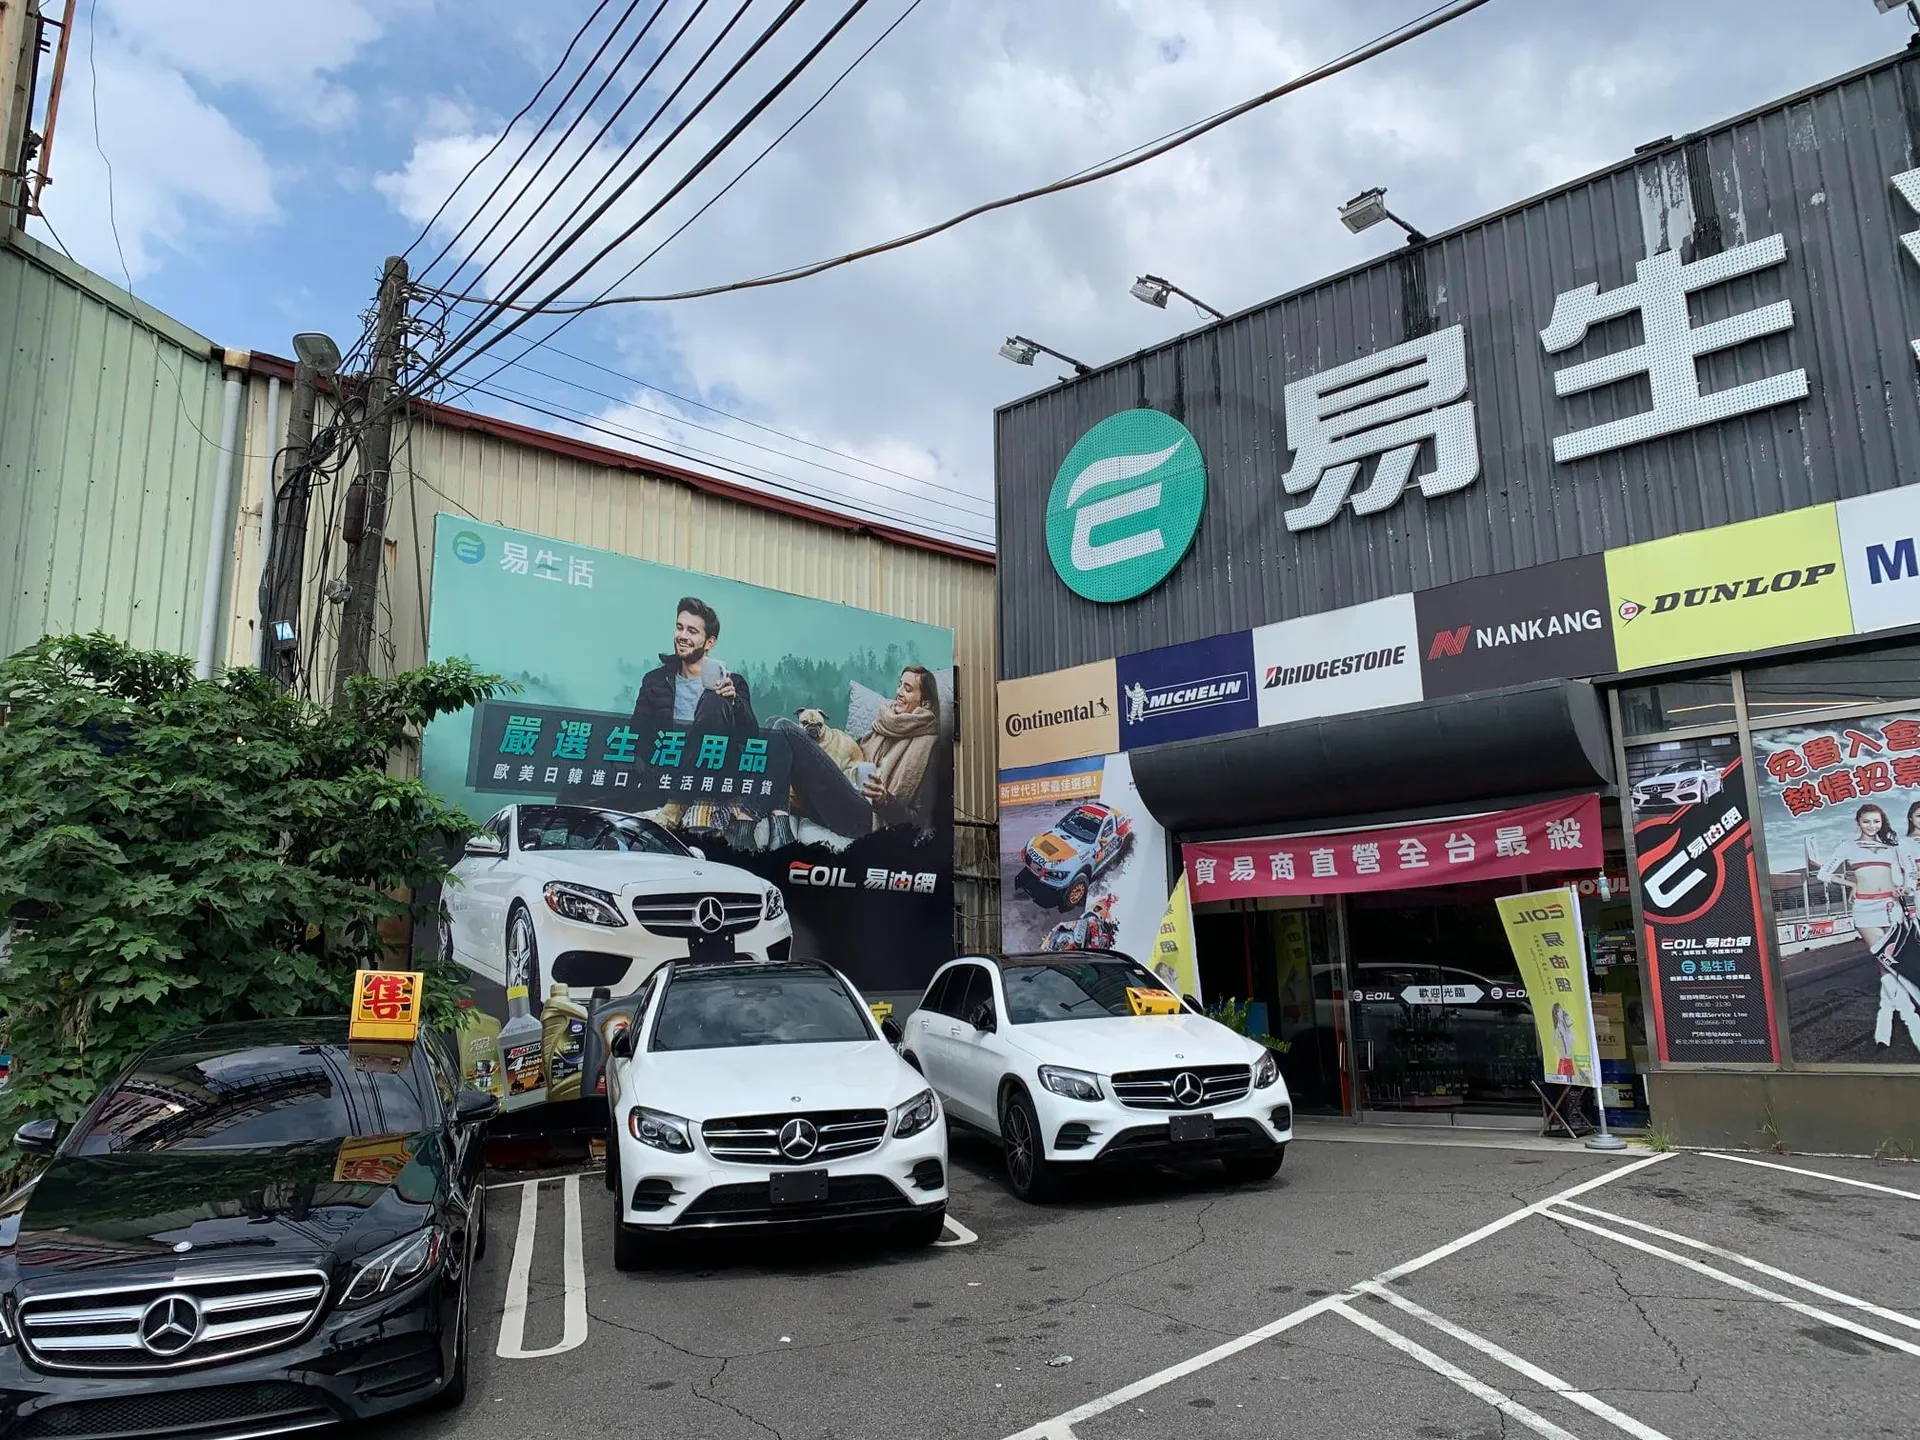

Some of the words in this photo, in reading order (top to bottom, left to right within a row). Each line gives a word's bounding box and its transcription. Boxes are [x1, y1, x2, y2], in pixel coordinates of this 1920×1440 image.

[500, 542, 595, 589] 易生活
[1651, 563, 1836, 614] DUNLOP
[1476, 609, 1602, 649] NANKANG
[1264, 645, 1406, 689] BRIDGESTONE
[1149, 680, 1241, 708] MICHELIN
[1005, 701, 1094, 737] Continental
[499, 714, 769, 774] 嚴選生活用品
[1766, 719, 1920, 783] 免費入會
[1782, 755, 1920, 817] 熱情招募
[1195, 816, 1583, 886] 貿易商直營全台最殺
[863, 867, 937, 895] 易油網
[1700, 960, 1736, 973] 易生活
[363, 975, 412, 1020] 售
[1418, 987, 1466, 999] 歡迎光臨
